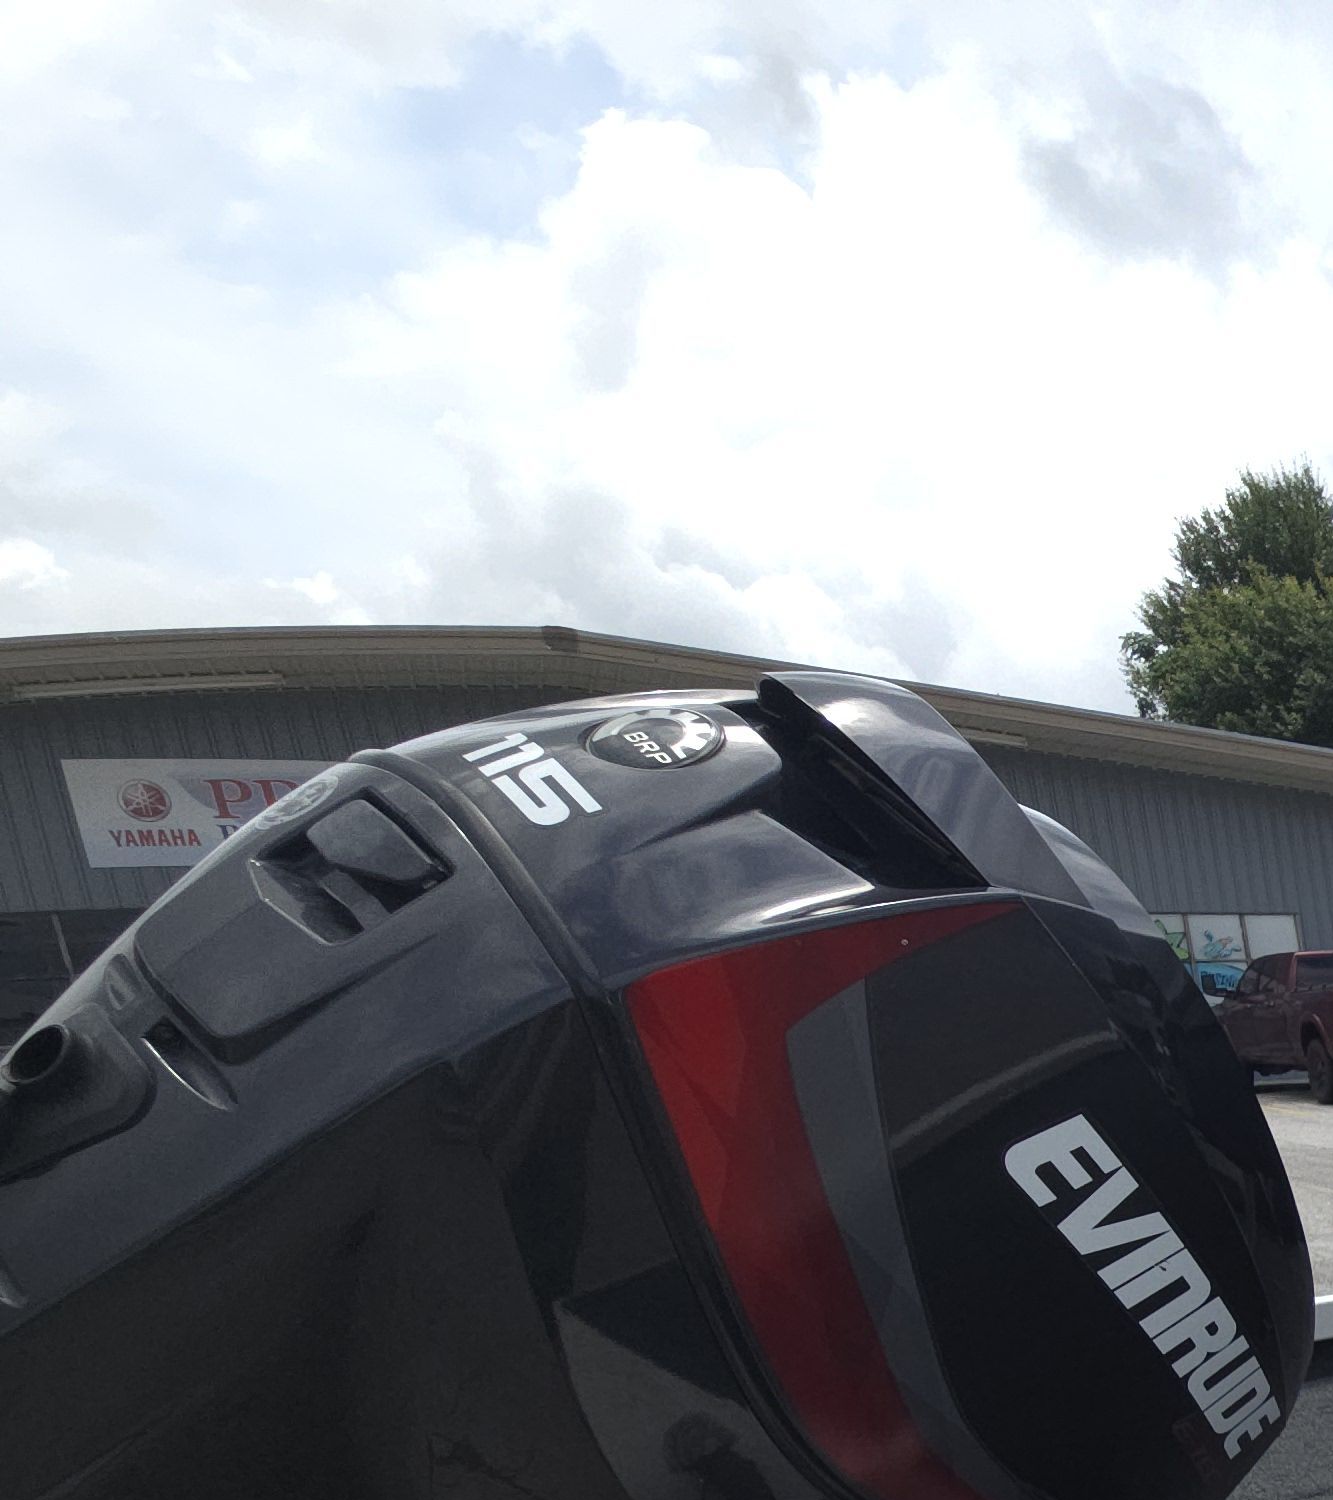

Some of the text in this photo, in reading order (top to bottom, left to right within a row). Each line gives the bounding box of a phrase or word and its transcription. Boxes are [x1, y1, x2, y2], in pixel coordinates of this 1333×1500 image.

[462, 732, 603, 826] 115
[623, 731, 672, 764] BRP
[108, 828, 202, 848] YAMAHA
[1003, 1113, 1282, 1461] EVINRUDE
